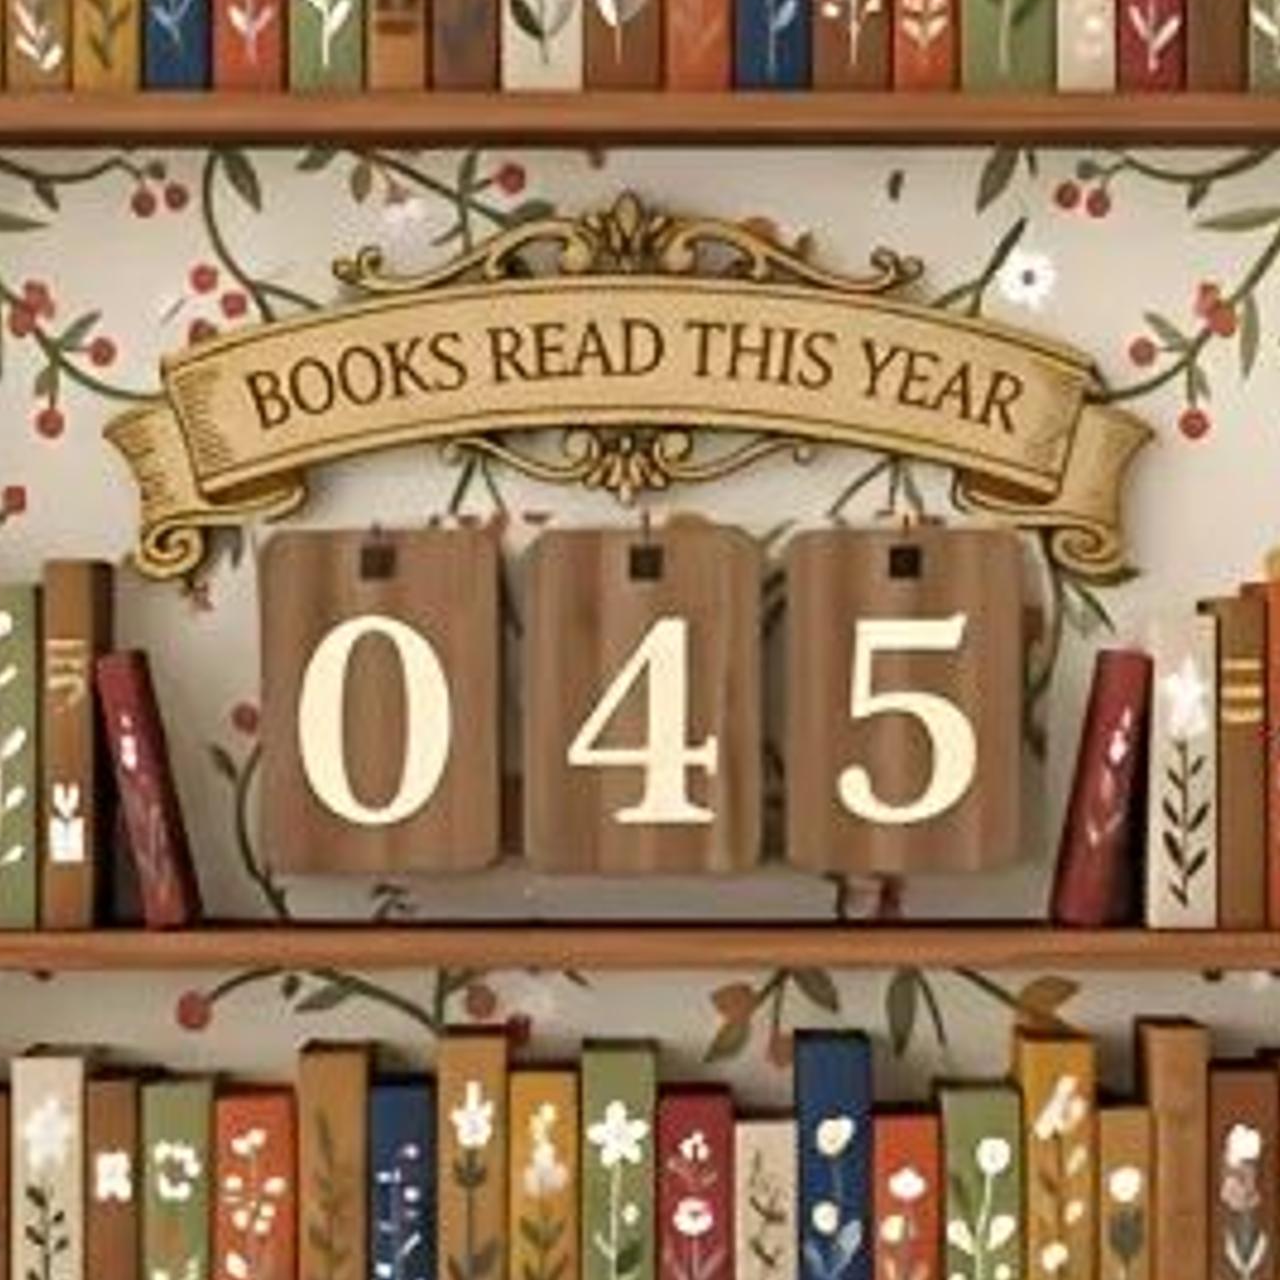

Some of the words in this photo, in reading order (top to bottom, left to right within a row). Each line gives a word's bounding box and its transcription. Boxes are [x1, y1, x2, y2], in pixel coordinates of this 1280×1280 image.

[243, 332, 468, 431] BOOKS
[488, 318, 666, 386] READ
[685, 320, 838, 390] THIS
[860, 340, 1025, 434] YEAR
